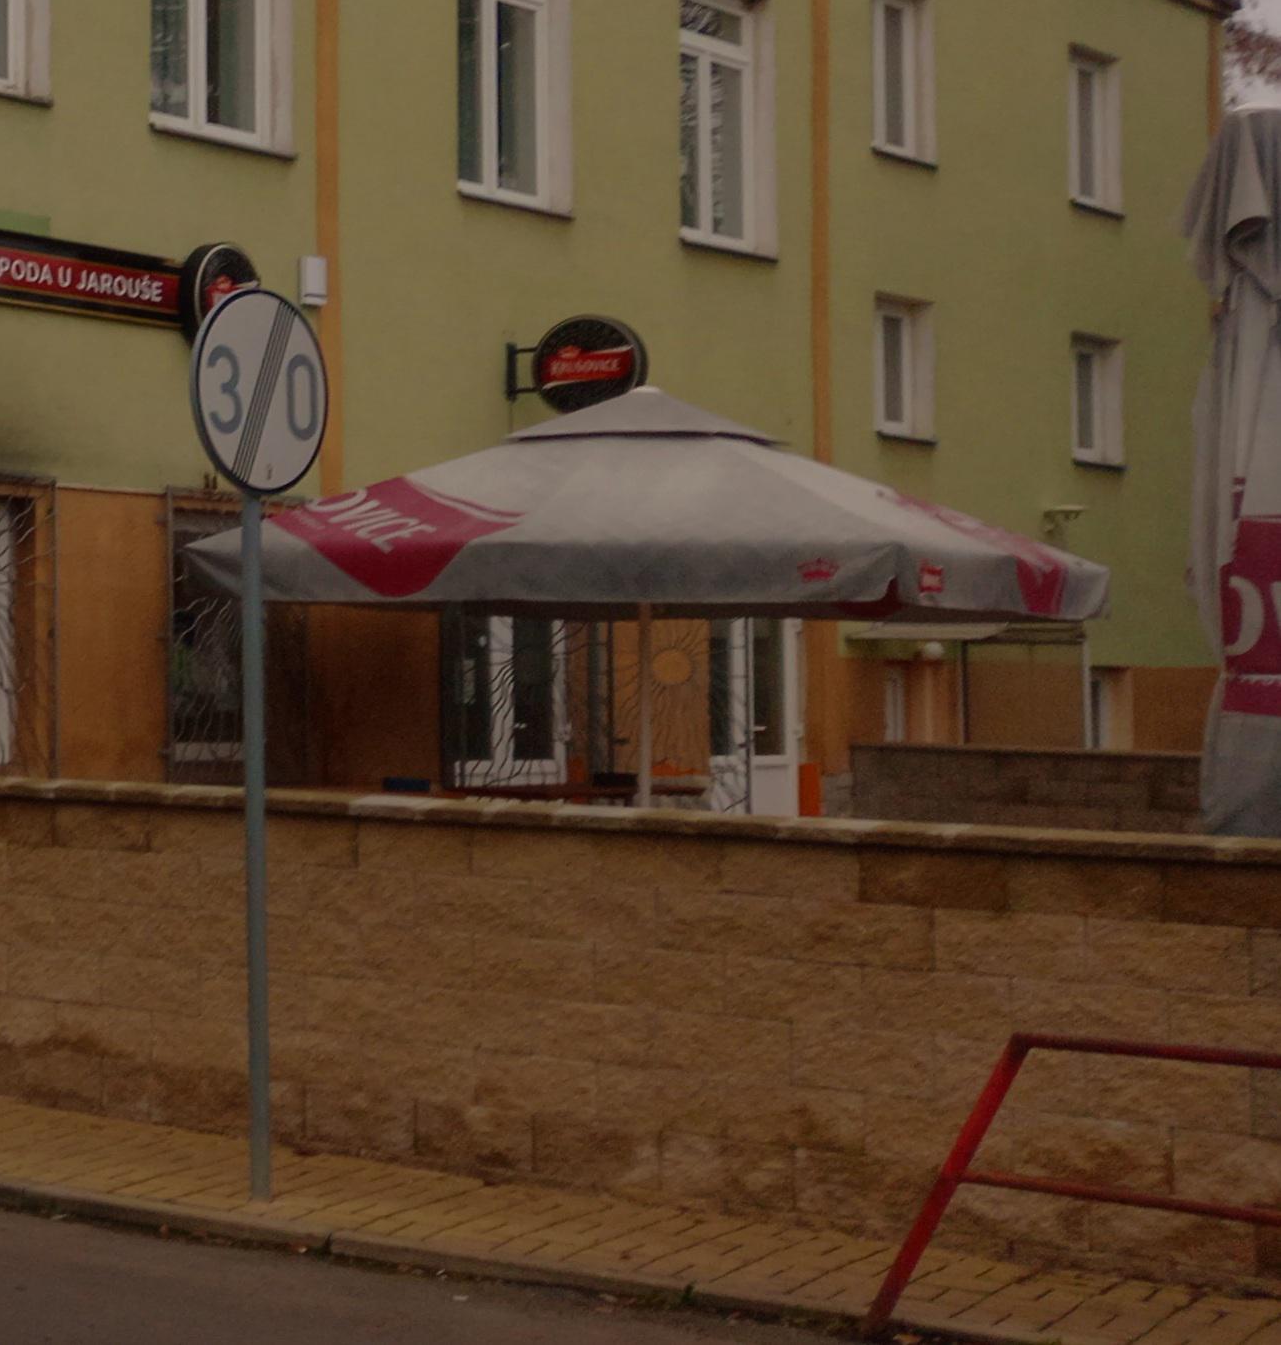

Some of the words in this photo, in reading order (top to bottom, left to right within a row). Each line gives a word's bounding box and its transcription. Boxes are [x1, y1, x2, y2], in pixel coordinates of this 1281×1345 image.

[58, 266, 72, 288] U
[76, 269, 164, 302] JAROUŠE
[207, 344, 319, 441] 30
